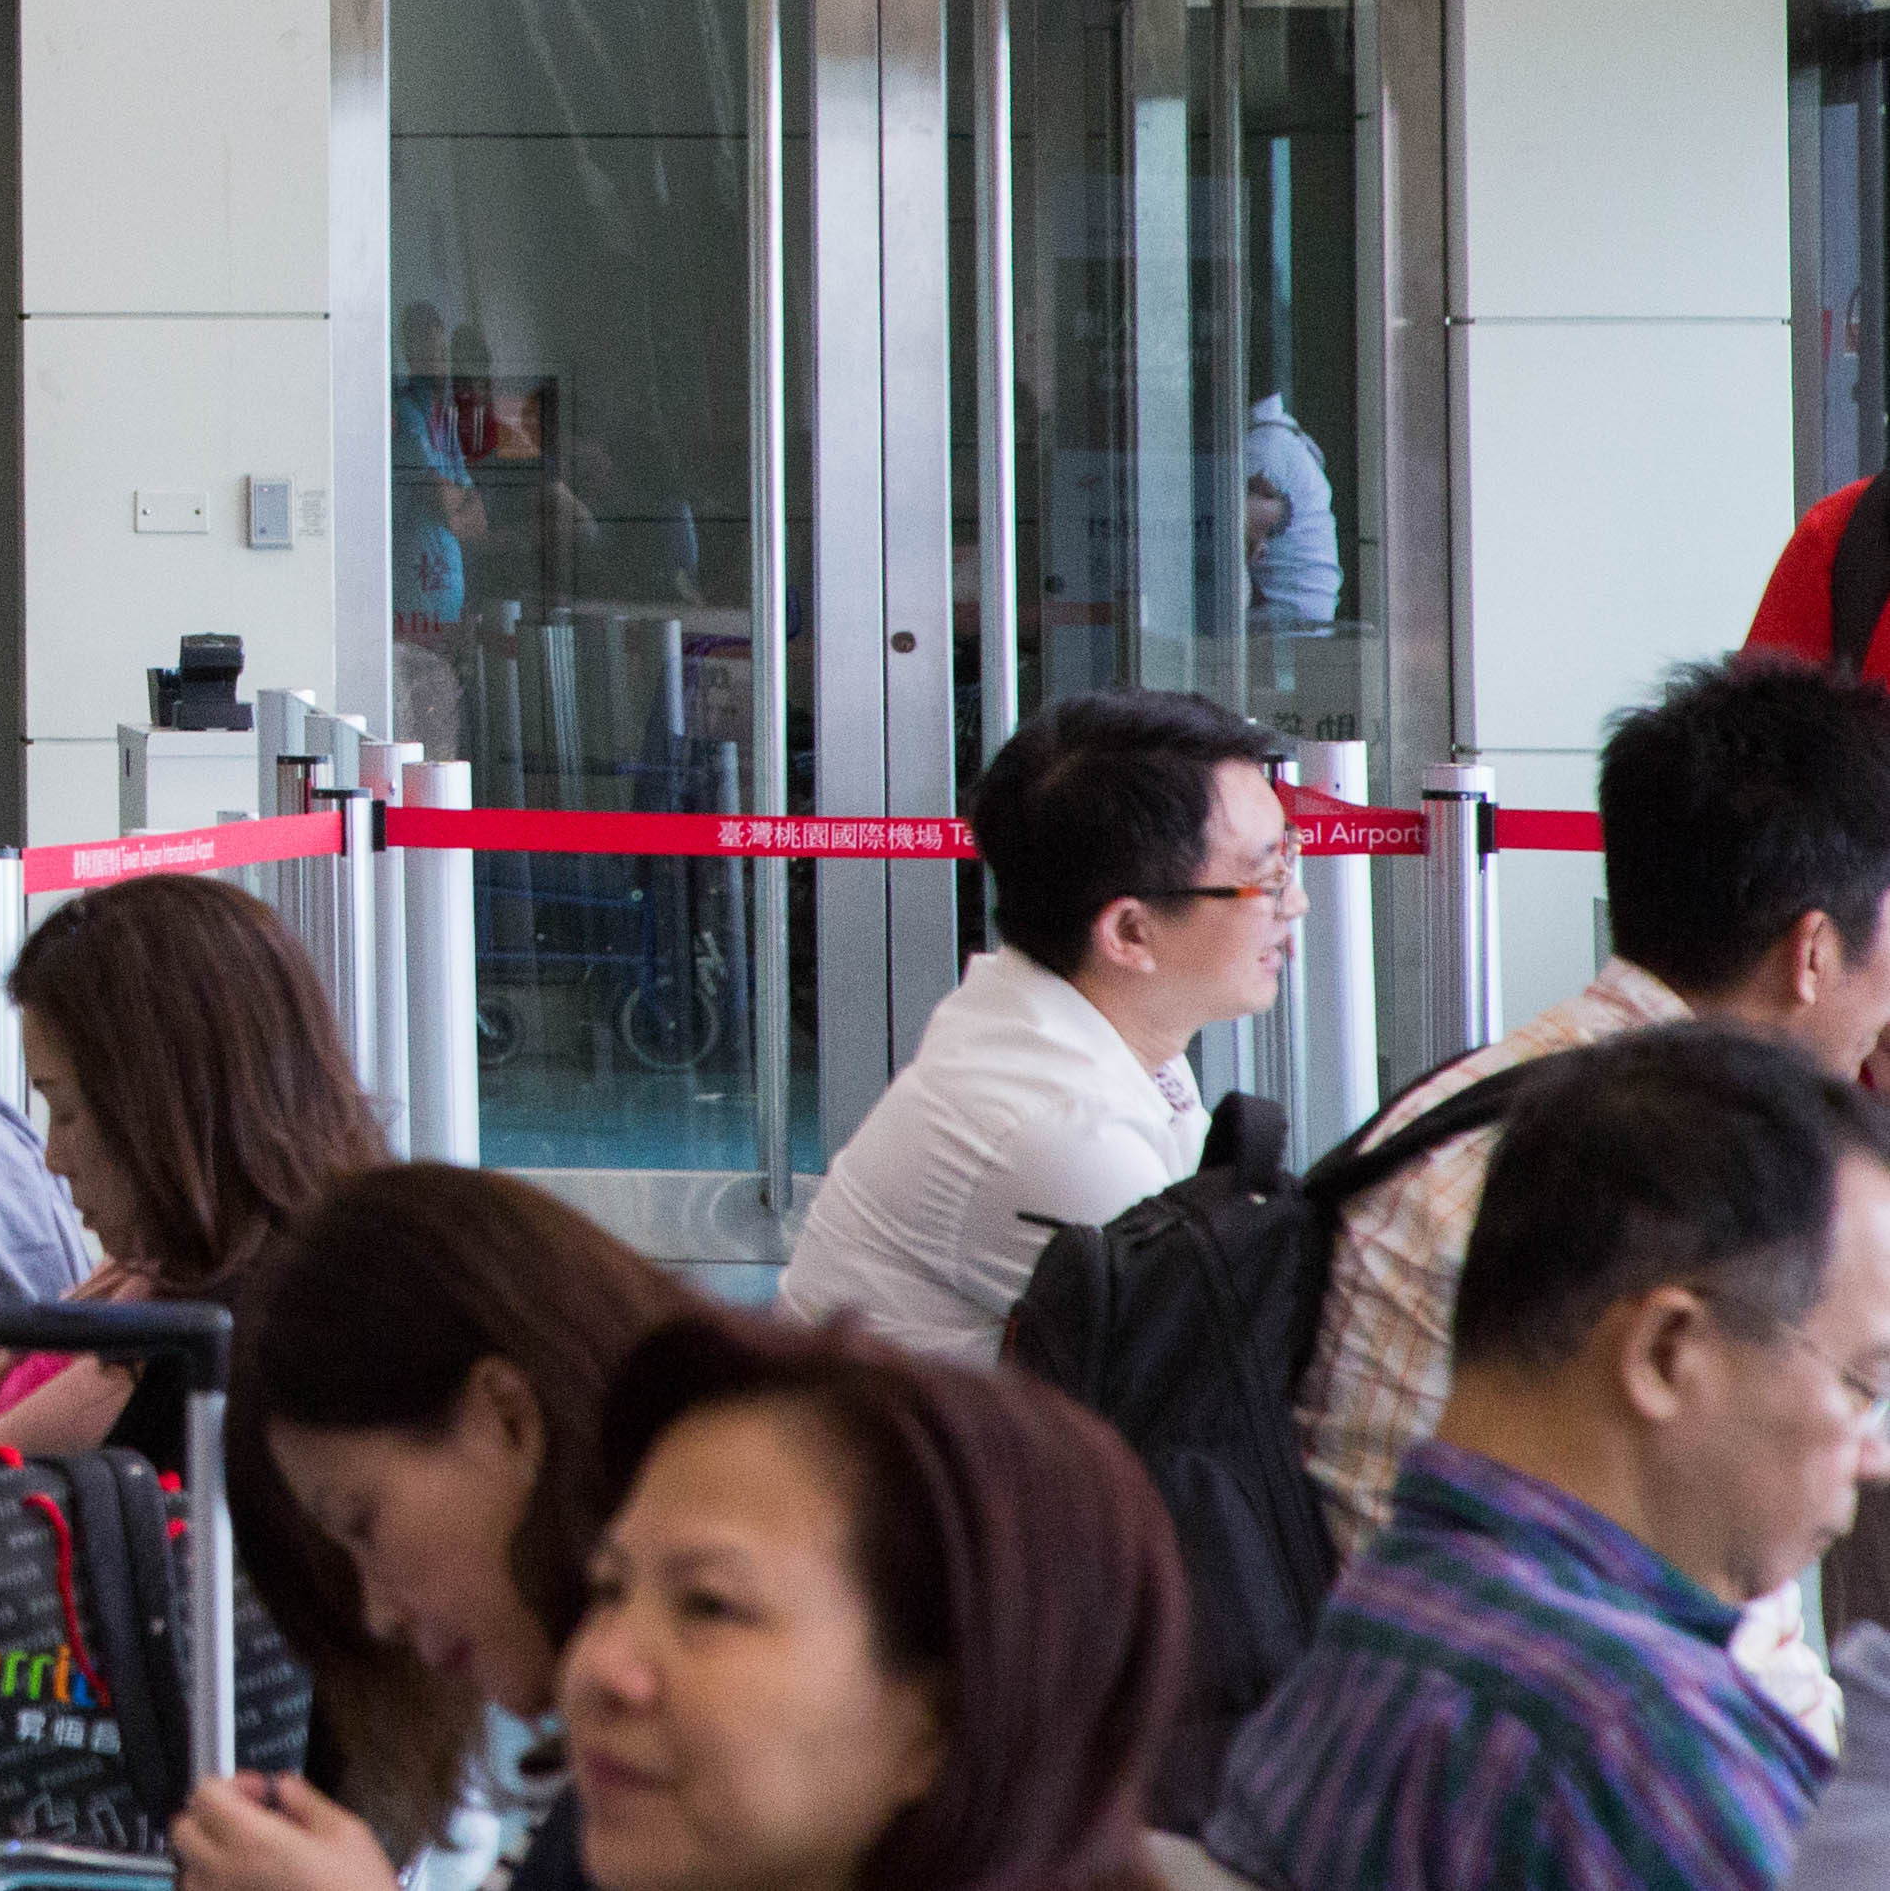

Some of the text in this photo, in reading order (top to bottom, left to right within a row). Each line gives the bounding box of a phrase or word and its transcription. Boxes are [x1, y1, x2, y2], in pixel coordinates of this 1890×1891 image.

[718, 819, 942, 851] 臺灣桃園國際機場
[1329, 822, 1425, 850] Airport
